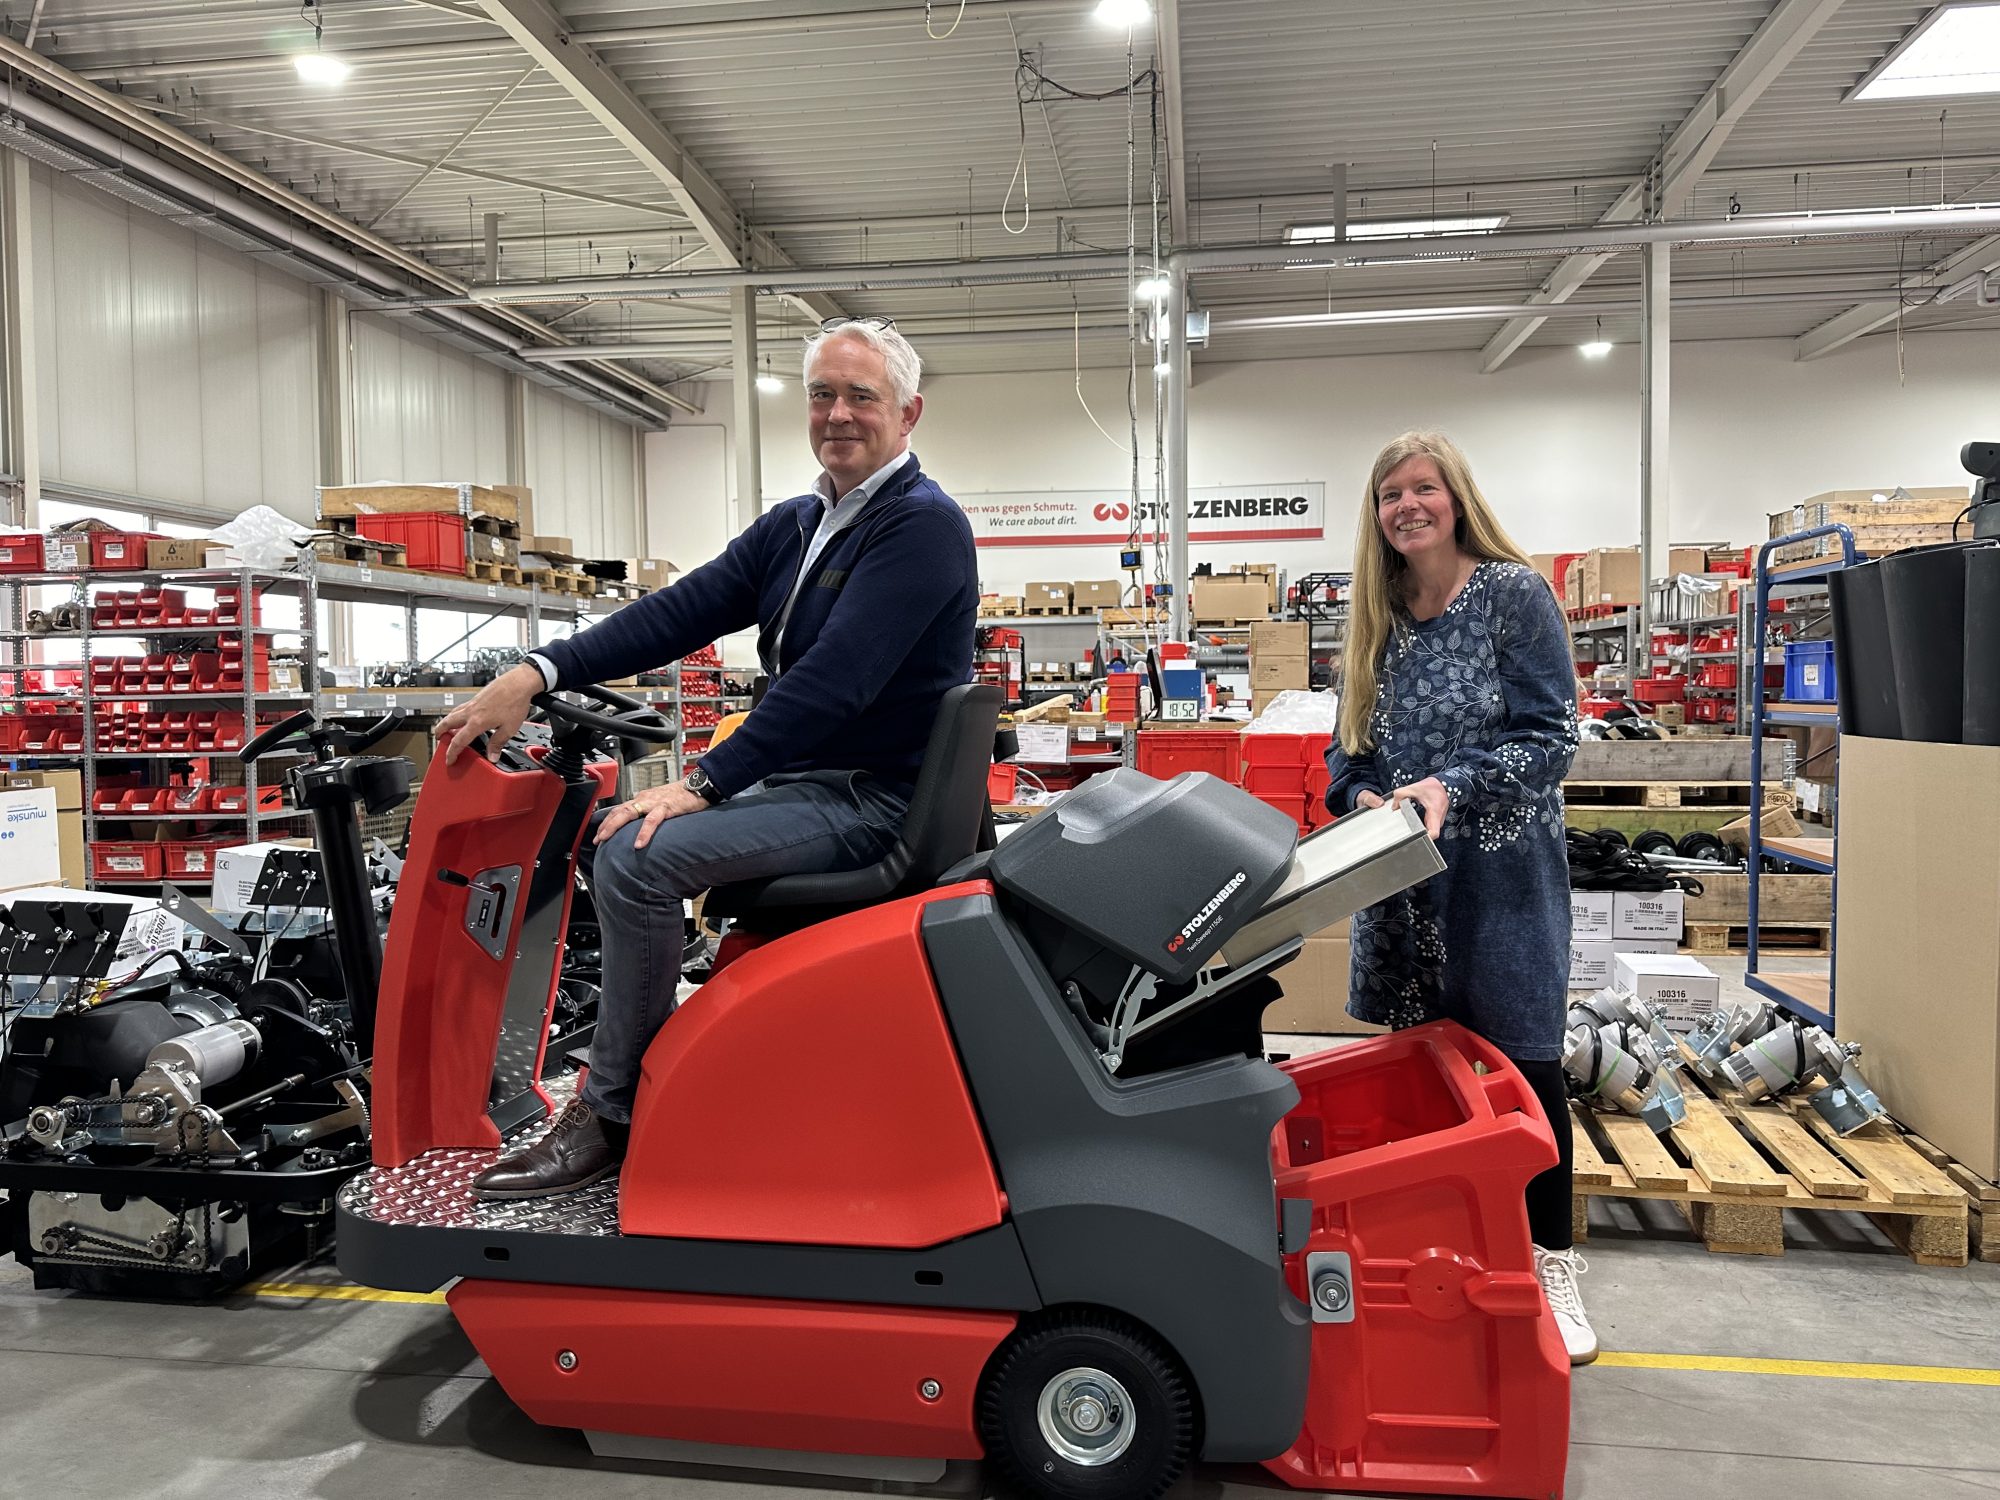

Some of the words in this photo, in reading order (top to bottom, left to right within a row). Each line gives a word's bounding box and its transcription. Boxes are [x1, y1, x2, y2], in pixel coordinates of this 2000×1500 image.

[961, 505, 979, 513] ben
[1002, 504, 1031, 514] gegen
[1033, 502, 1077, 512] Schmutz.
[1134, 497, 1308, 520] STZENBERG
[990, 518, 1003, 526] We
[1006, 518, 1025, 526] care
[1028, 516, 1055, 526] about
[1057, 516, 1077, 525] dirt.
[7, 809, 47, 823] miunske
[1182, 872, 1246, 939] STOLZENBERG
[1572, 906, 1588, 914] 0316
[1639, 902, 1663, 910] 100316
[150, 914, 167, 945] 100316
[1657, 990, 1686, 998] 100316
